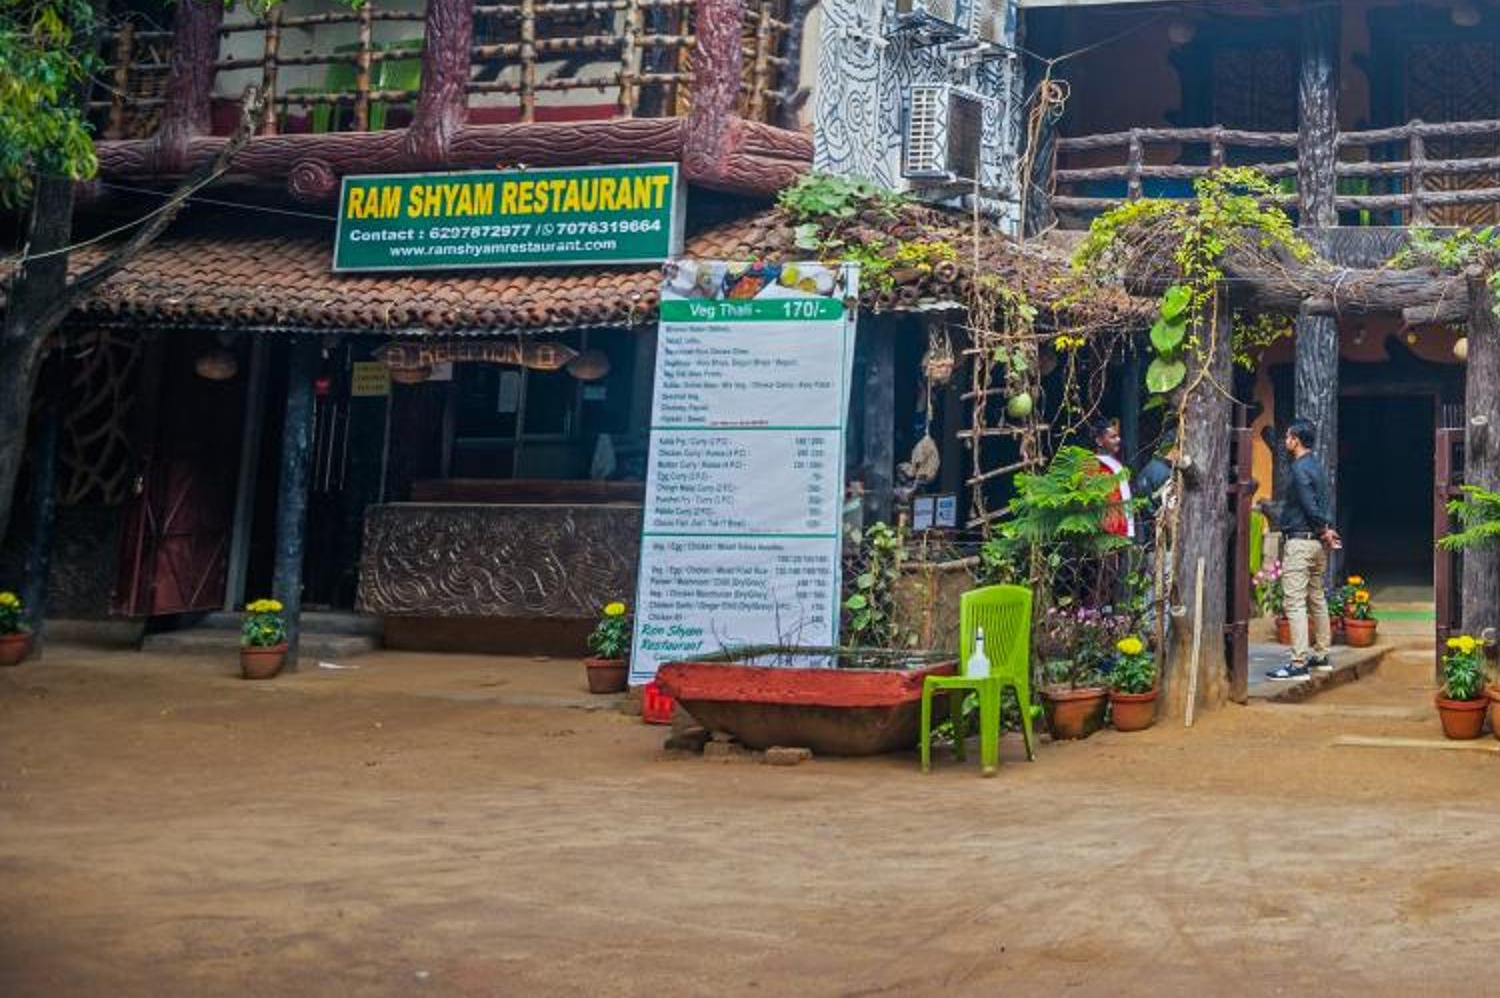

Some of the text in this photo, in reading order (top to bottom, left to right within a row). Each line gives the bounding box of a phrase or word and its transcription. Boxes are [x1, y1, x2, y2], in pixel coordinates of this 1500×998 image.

[347, 175, 670, 219] RAM SHYAM RESTAURANT
[350, 228, 415, 241] Contact
[429, 223, 532, 240] 6297872977
[389, 239, 617, 257] www.ramshyamrestaurant.com
[689, 303, 715, 318] Veg
[720, 302, 753, 317] Thali
[783, 301, 827, 318] 170/-
